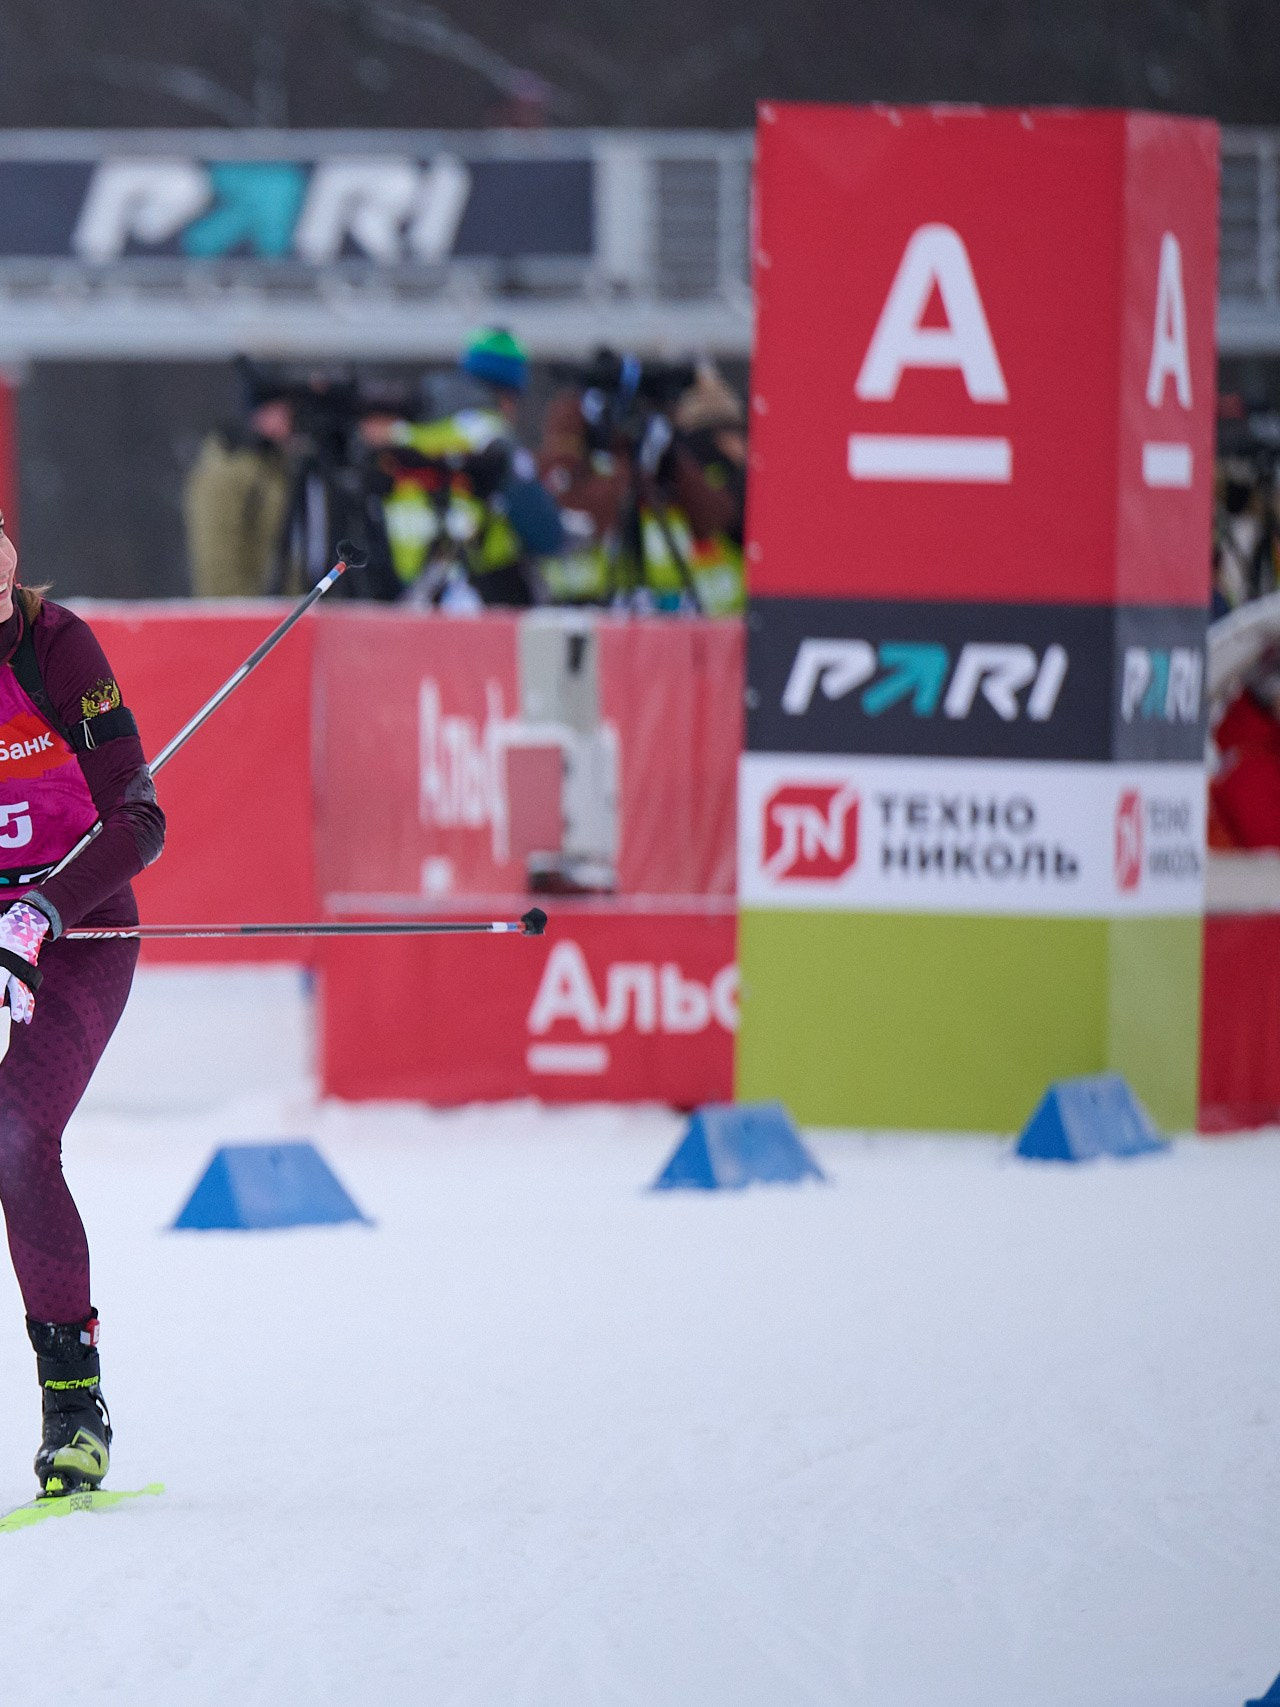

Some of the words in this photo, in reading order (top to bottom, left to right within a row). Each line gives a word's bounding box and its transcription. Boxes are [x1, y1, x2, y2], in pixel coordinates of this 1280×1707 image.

[782, 637, 1069, 721] PARI
[874, 793, 1035, 829] ТЕХНО
[880, 841, 1079, 881] НИКОЛЬ
[45, 1375, 99, 1390] FISCHER
